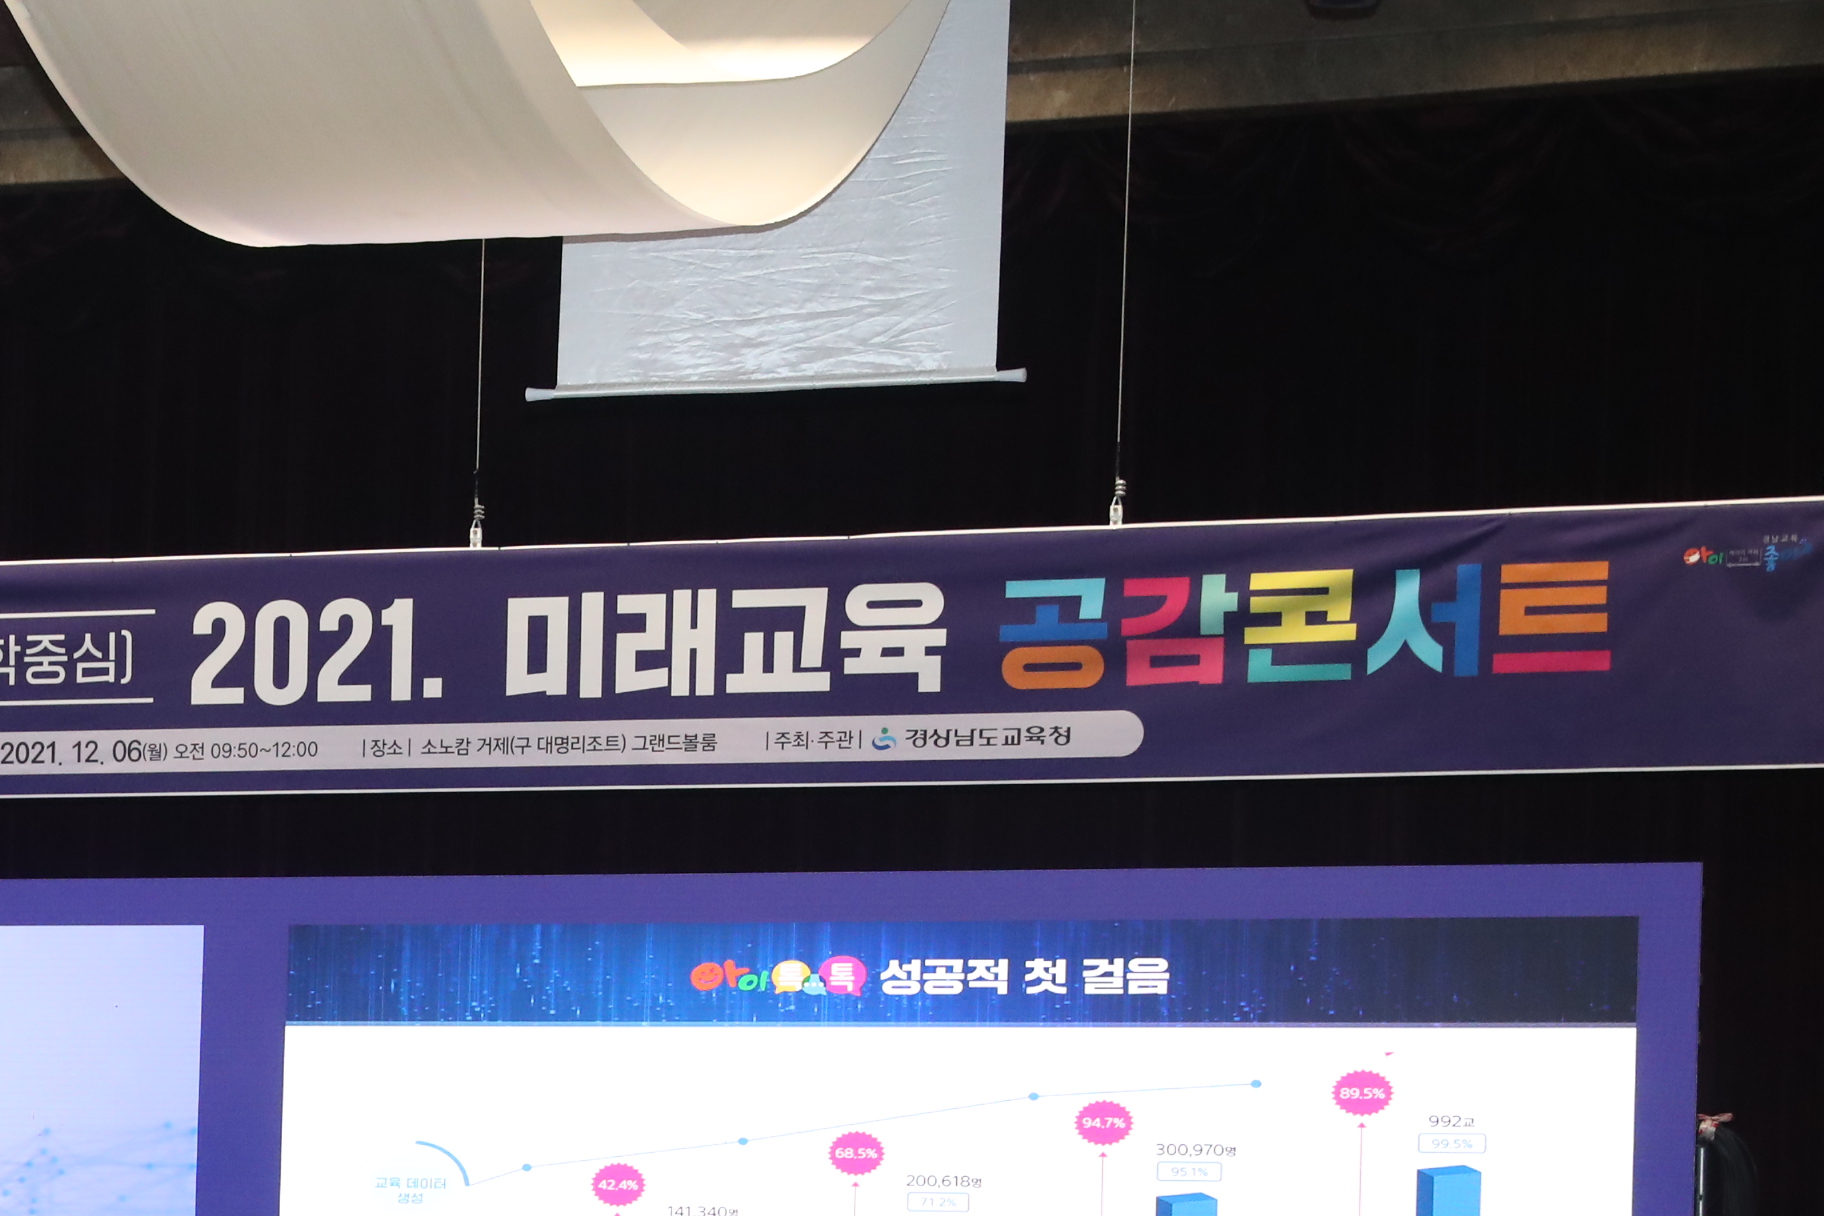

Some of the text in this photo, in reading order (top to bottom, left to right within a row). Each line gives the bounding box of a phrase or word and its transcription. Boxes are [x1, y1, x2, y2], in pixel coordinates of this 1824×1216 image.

[1683, 545, 1725, 567] 아이
[190, 560, 1612, 706] 2021. 미래교육 공감콘서트
[369, 732, 717, 757] 장소 소노캄 거제(구 대명리조트) 그랜드볼룸
[773, 725, 1072, 751] 주최·주관 경상남도교육청
[0, 741, 63, 767] 2021.
[72, 740, 105, 766] 12.
[112, 740, 169, 764] 06(월)
[173, 742, 205, 762] 오전
[210, 740, 319, 760] 09:50~12:00
[689, 955, 1170, 997] 아이톡톡 성공적 첫 걸음
[1339, 1087, 1386, 1100] 89.5%
[1082, 1117, 1126, 1130] 94.7%
[1428, 1115, 1475, 1128] 992교
[1156, 1143, 1237, 1158] 300,970명
[1431, 1138, 1473, 1149] 99.5%
[834, 1147, 878, 1160] 68.5%
[375, 1176, 447, 1190] 교육 데이터
[598, 1179, 639, 1191] 42.4%
[906, 1174, 982, 1189] 200,618명
[397, 1192, 424, 1205] 생성
